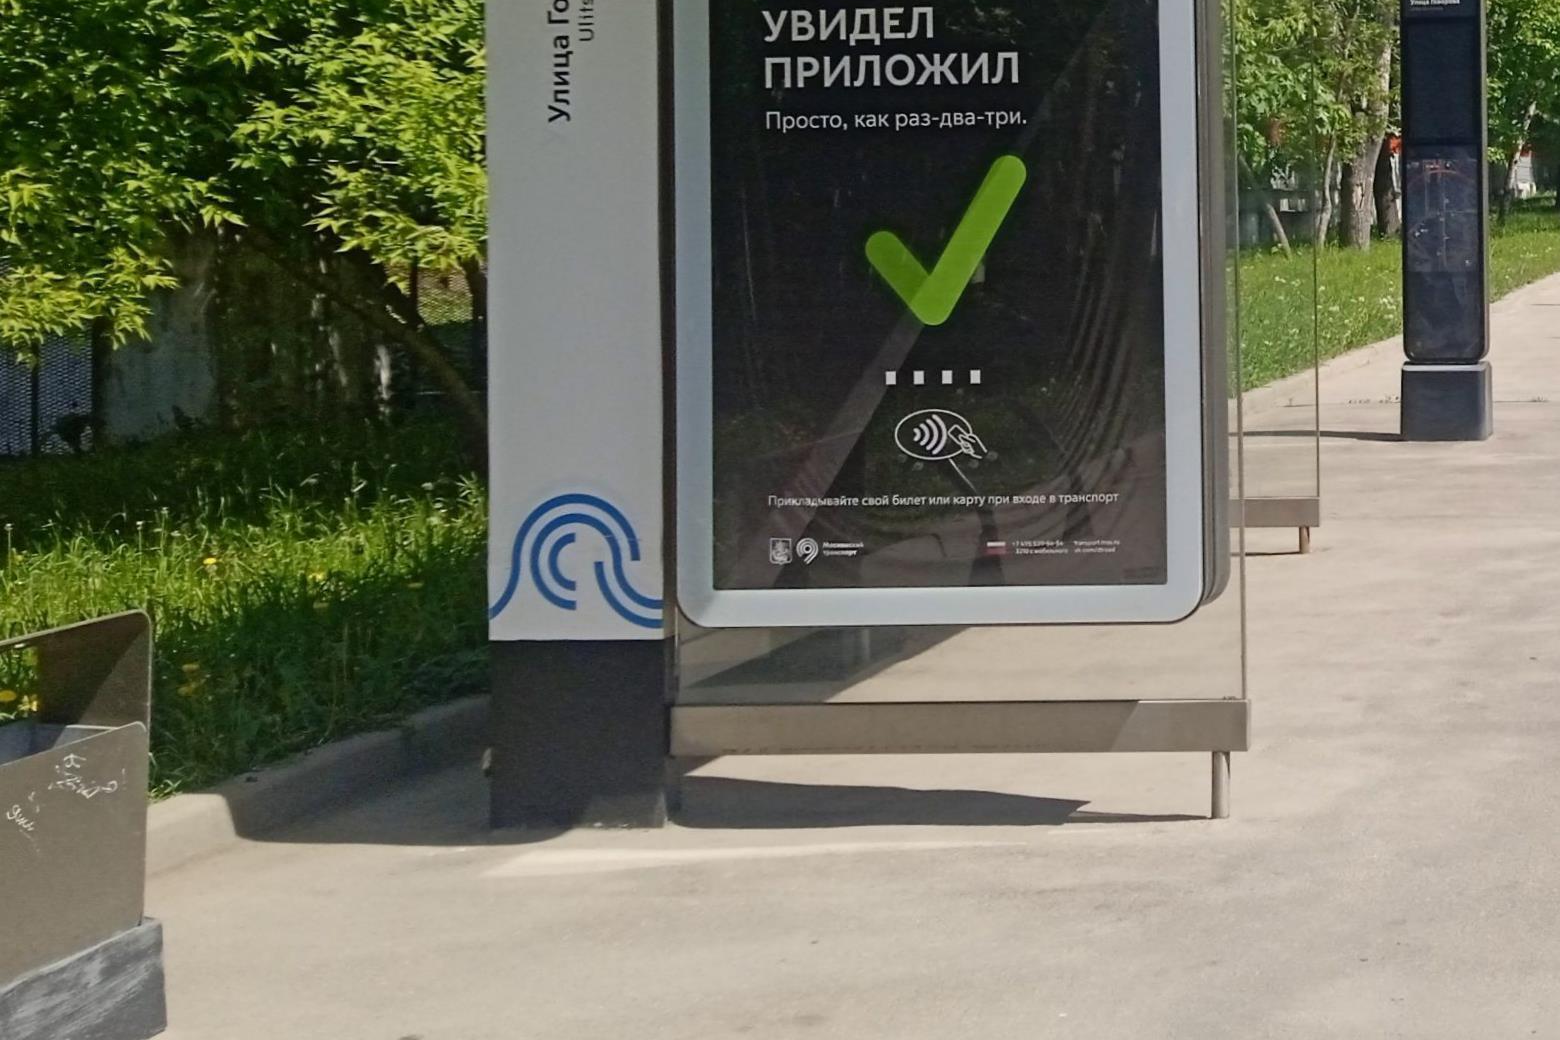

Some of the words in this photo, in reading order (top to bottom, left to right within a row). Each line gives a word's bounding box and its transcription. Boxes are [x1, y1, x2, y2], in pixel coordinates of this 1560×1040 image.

[762, 6, 934, 46] УВИДЕЛ
[547, 35, 573, 123] Улица
[764, 51, 1019, 89] ПРИЛОЖИЛ
[765, 110, 848, 134] Просто,
[854, 113, 889, 128] как
[894, 109, 1027, 132] раз-два-три.
[768, 495, 859, 508] Прикладывайте
[861, 495, 889, 506] свой
[892, 494, 926, 505] билет
[929, 496, 950, 505] или
[953, 496, 985, 507] карту
[988, 496, 1010, 506] при
[1012, 495, 1046, 505] входе
[1049, 495, 1056, 504] в
[1058, 493, 1120, 505] транспорт
